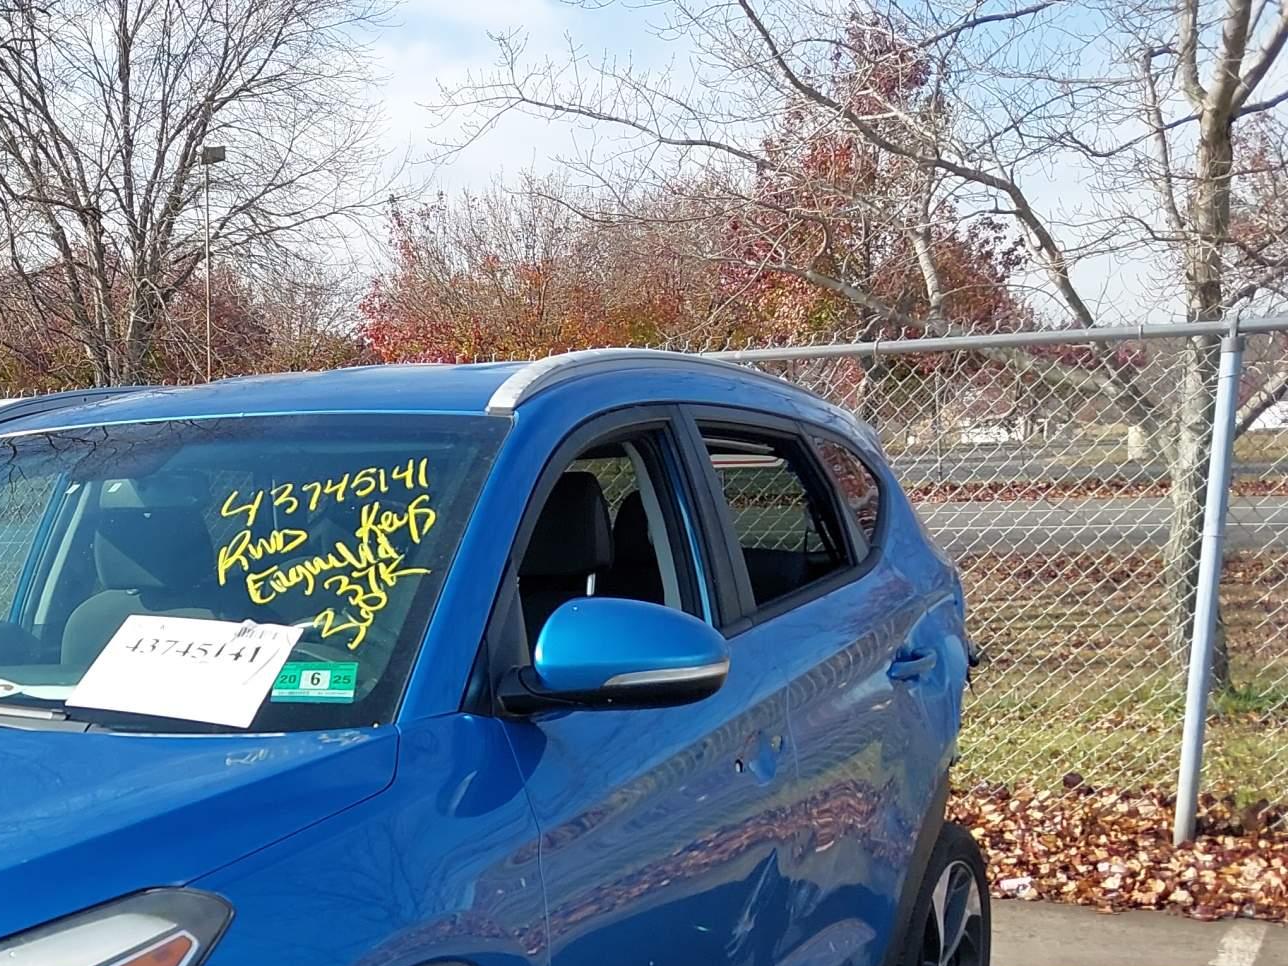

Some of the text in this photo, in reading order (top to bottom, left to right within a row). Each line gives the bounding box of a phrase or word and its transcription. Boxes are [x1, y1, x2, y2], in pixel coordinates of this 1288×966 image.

[220, 457, 429, 527] 43745141
[125, 637, 262, 664] 43745141
[279, 671, 352, 687] 20 6 25
